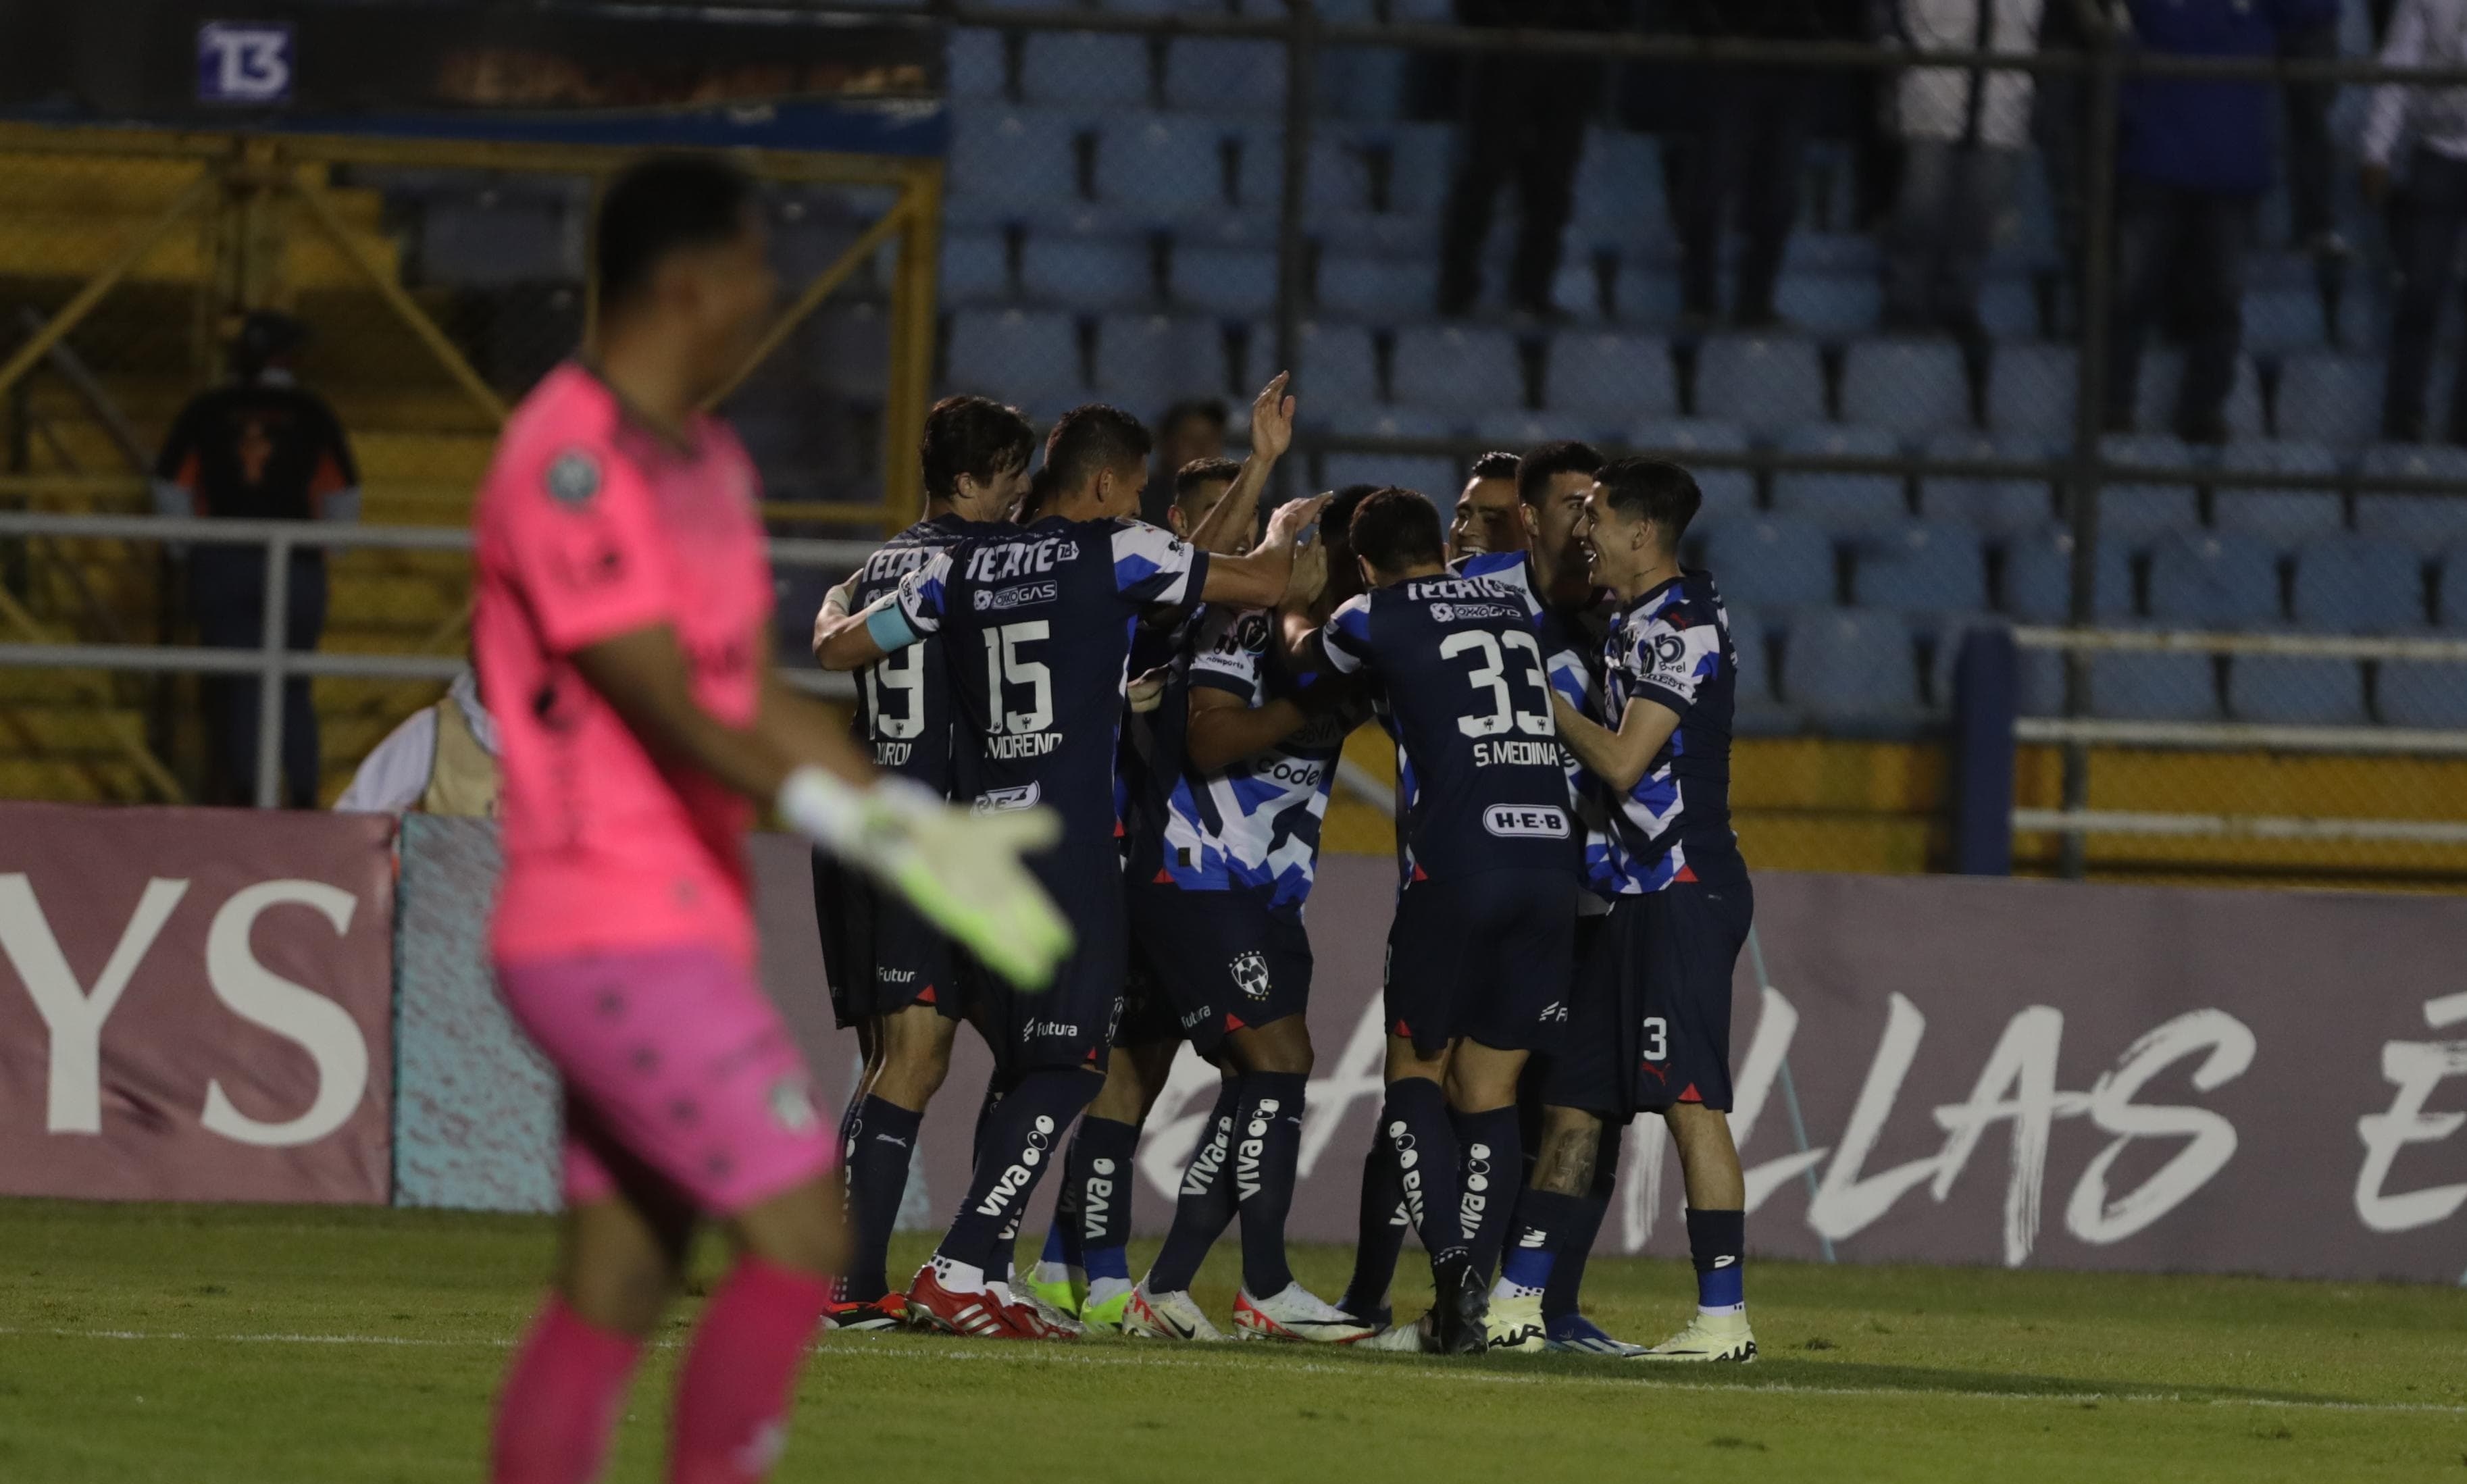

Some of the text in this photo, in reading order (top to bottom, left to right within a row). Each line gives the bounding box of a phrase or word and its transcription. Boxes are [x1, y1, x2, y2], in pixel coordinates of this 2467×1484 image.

[965, 538, 1061, 583] TECATE
[864, 640, 925, 740] 19
[982, 619, 1053, 735] 15
[1440, 630, 1556, 738] 33
[1473, 741, 1560, 767] S.MEDINA
[878, 967, 917, 983] Futur
[1644, 1017, 1667, 1060] 3
